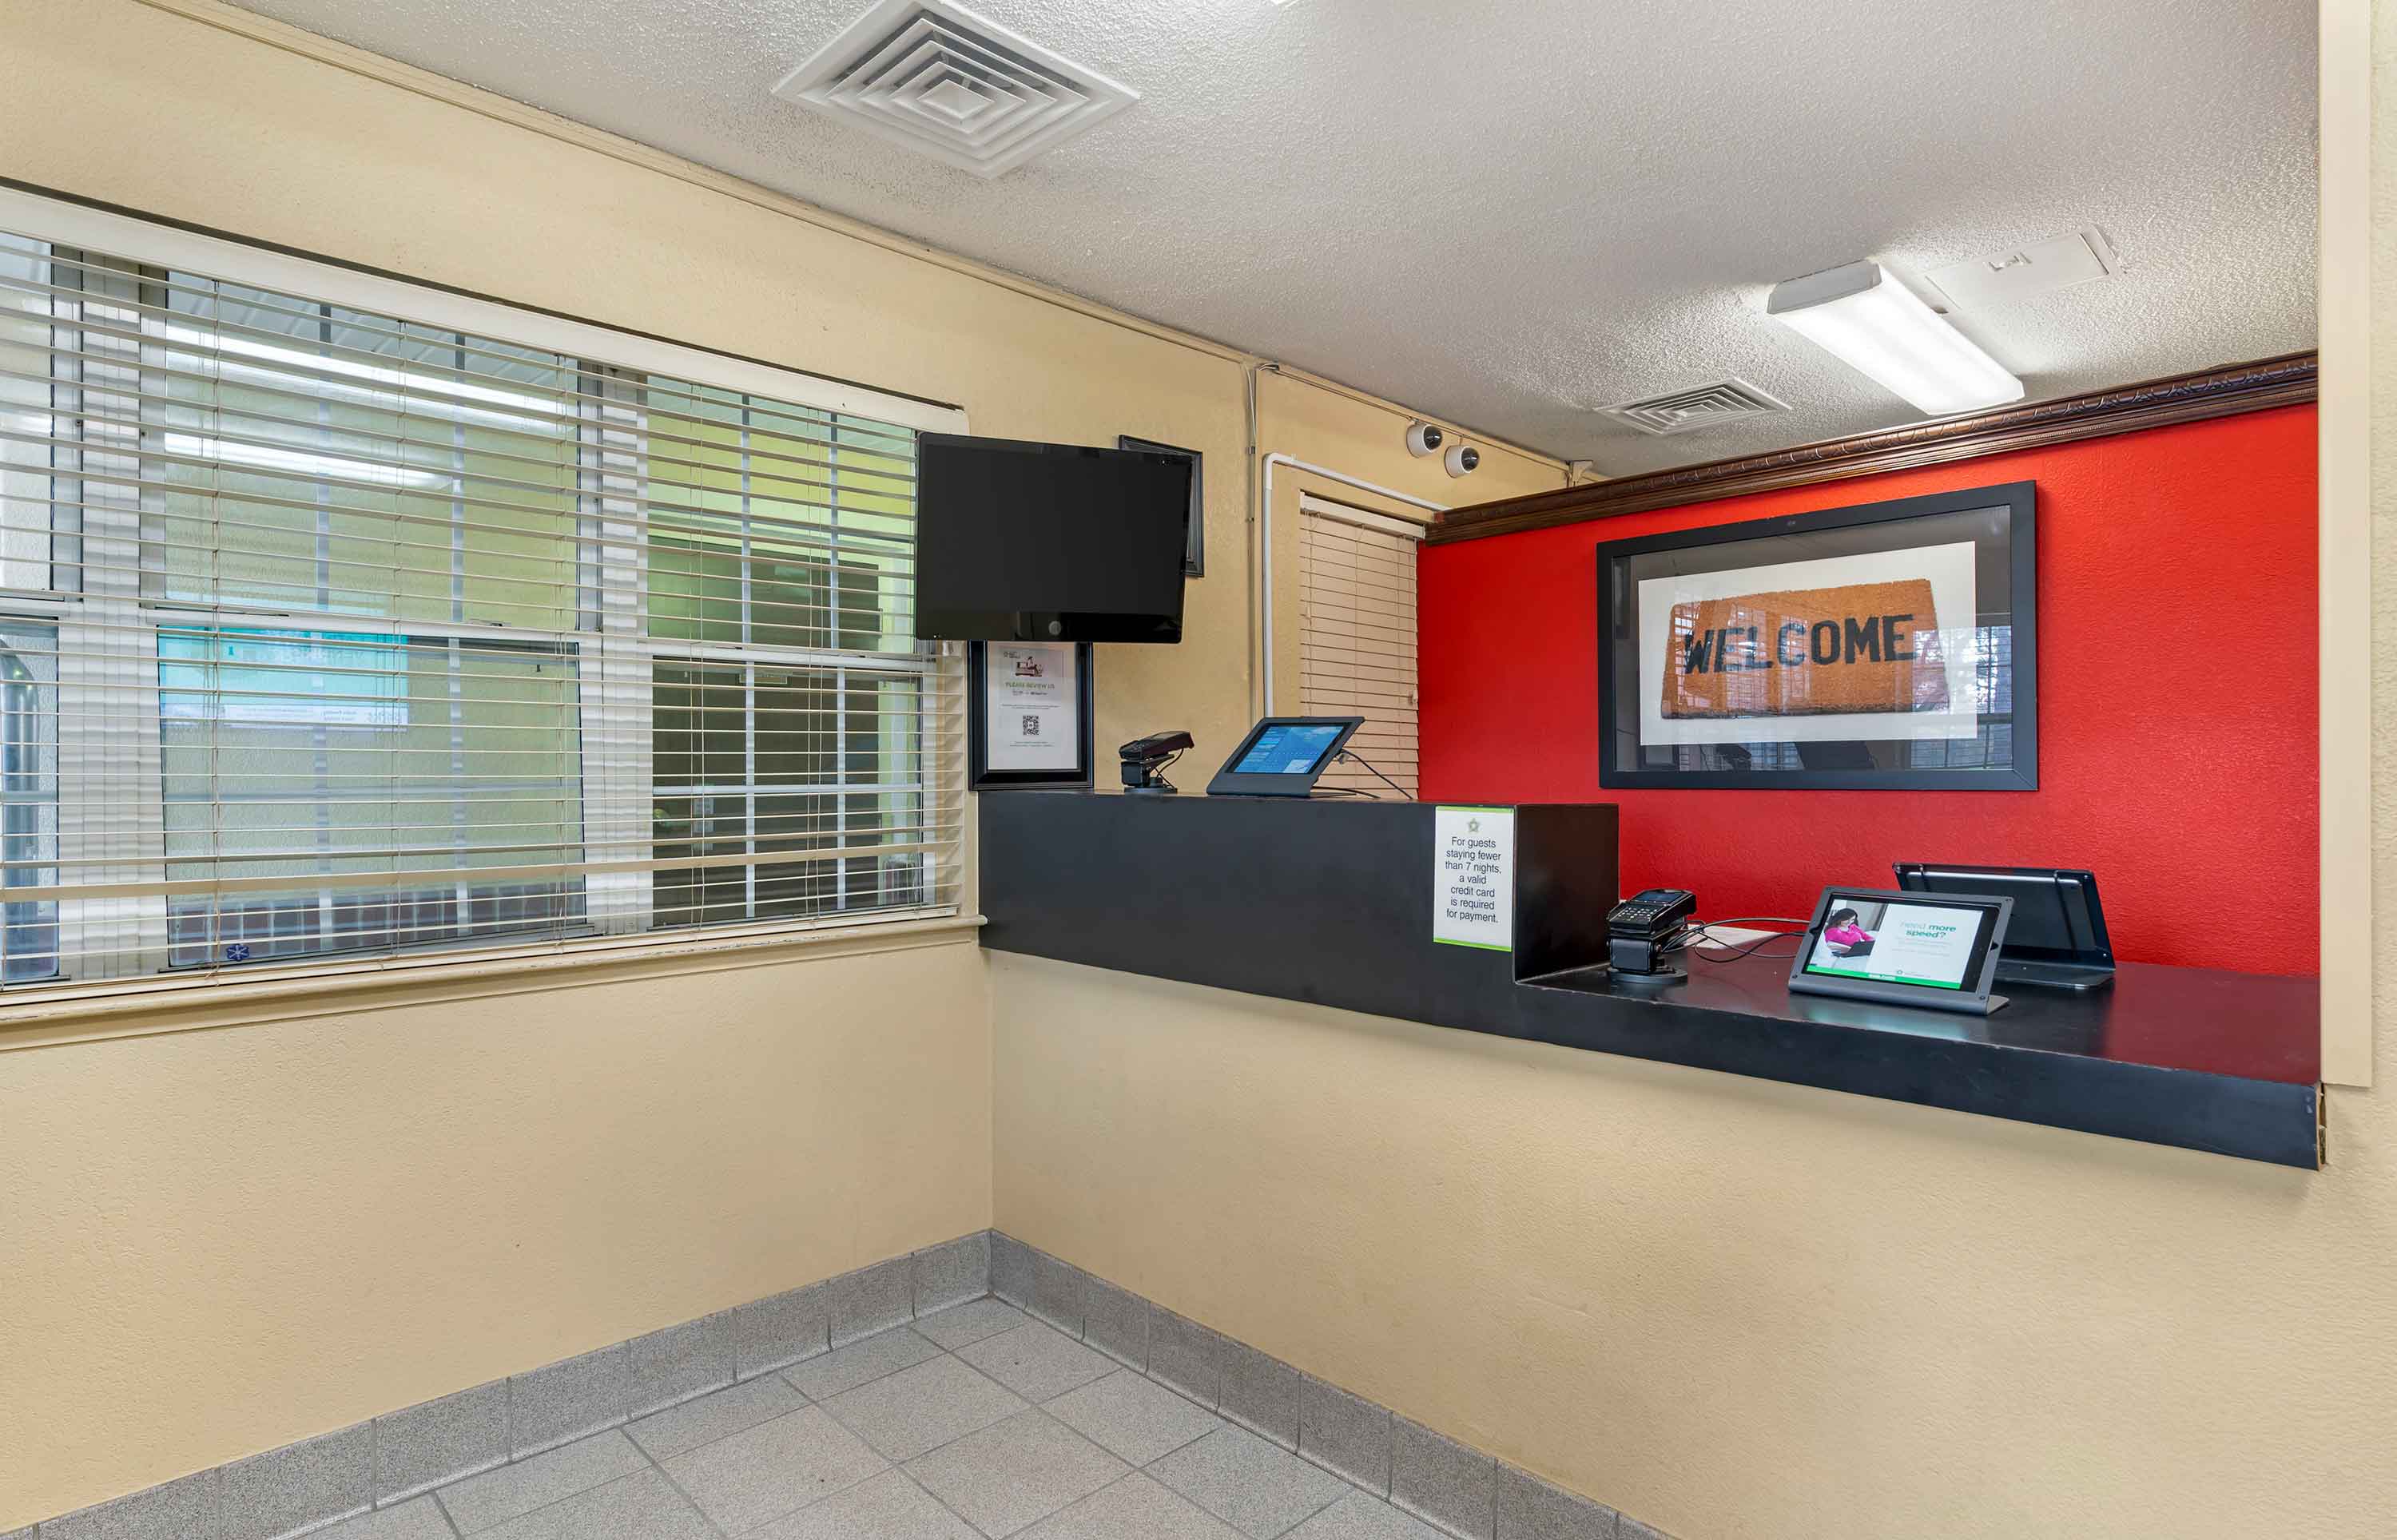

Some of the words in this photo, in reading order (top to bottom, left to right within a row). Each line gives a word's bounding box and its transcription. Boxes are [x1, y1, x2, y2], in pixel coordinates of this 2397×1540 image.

[1683, 613, 1918, 674] WELCOME
[1451, 836, 1465, 847] For
[1467, 838, 1497, 849] guests
[1446, 849, 1476, 861] staying
[1477, 850, 1501, 861] fewer
[1445, 861, 1463, 871] than
[1465, 862, 1471, 871] 7
[1473, 863, 1502, 874] nights,
[1467, 875, 1487, 884] valid
[1450, 886, 1473, 895] credit
[1476, 887, 1495, 897] card
[1450, 897, 1458, 907] is
[1460, 898, 1495, 911] required
[1446, 908, 1457, 919] for
[1459, 911, 1499, 923] payment.
[1906, 930, 1946, 939] speed?
